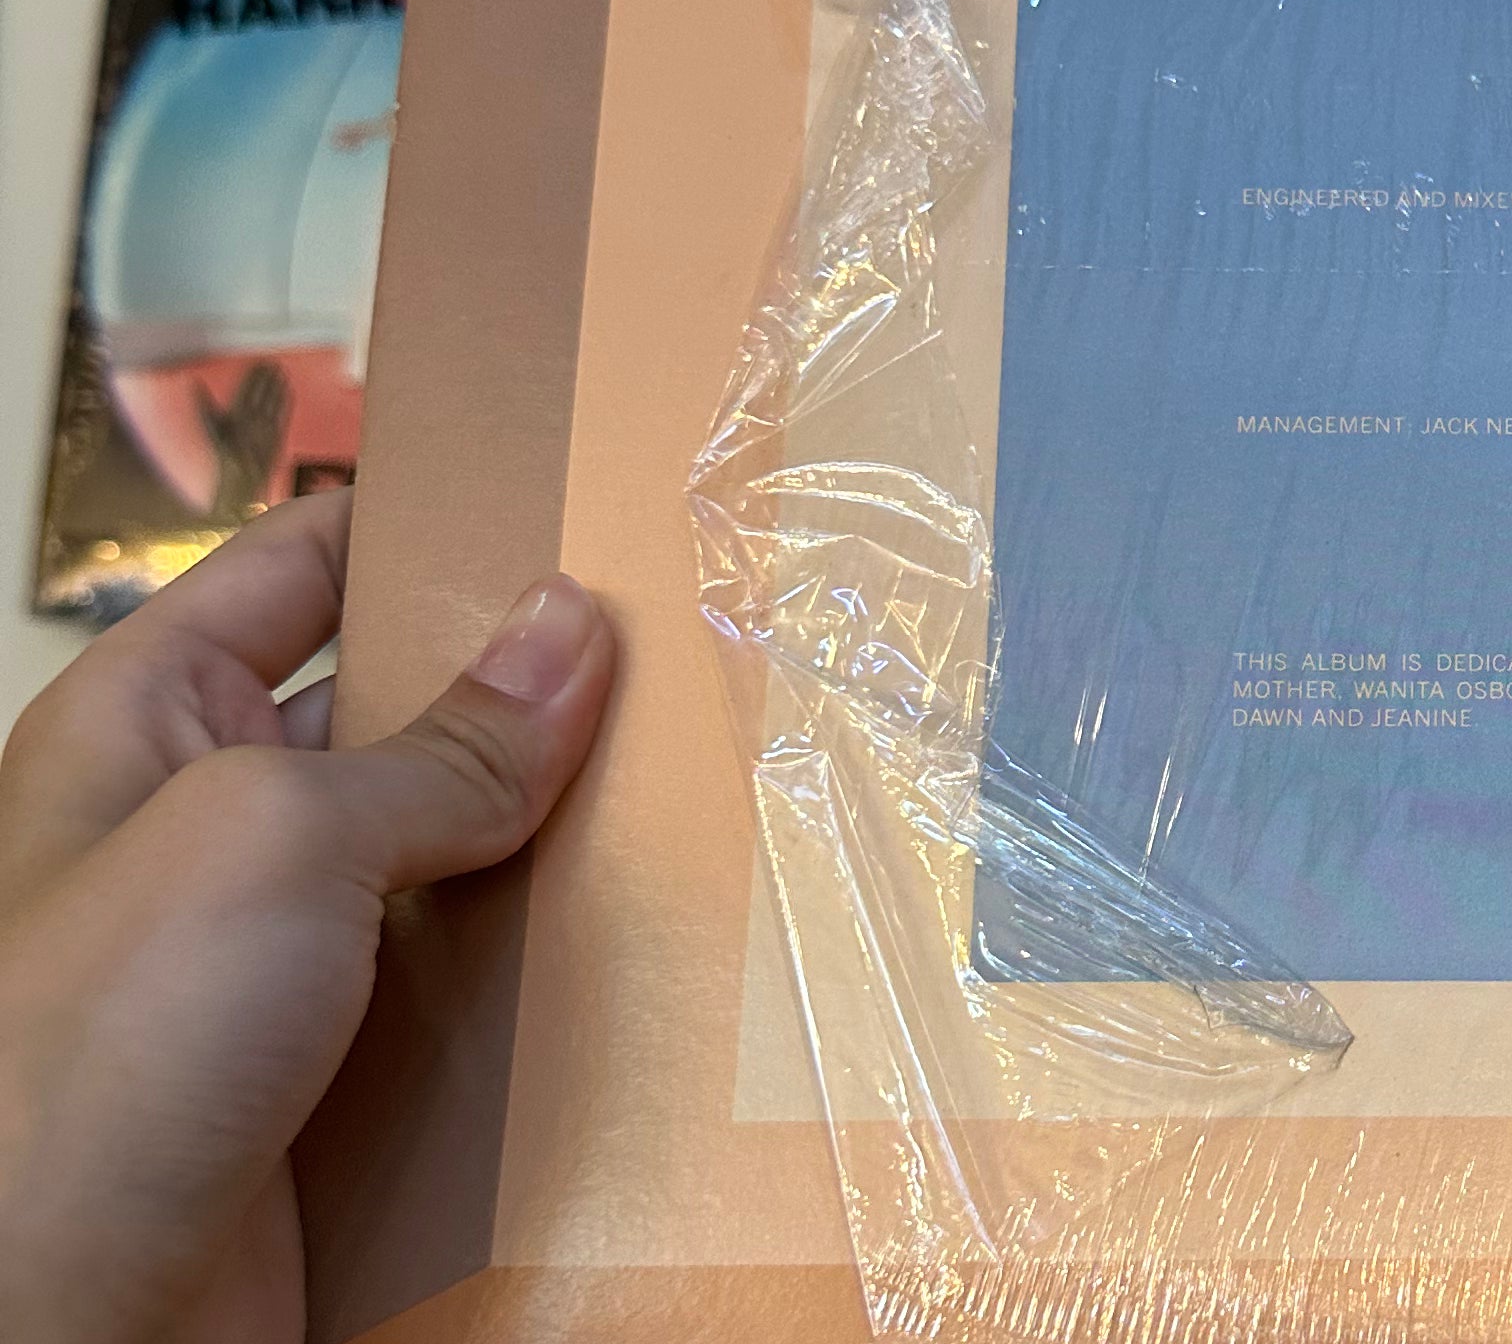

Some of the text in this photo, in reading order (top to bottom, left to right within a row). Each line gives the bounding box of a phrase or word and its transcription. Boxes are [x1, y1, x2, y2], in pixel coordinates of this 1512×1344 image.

[1241, 187, 1390, 208] ENGINEERED
[1396, 189, 1447, 209] AND
[1420, 416, 1479, 435] JACK
[1232, 652, 1288, 672] THIS
[1301, 653, 1387, 672] ALBUM
[1401, 653, 1422, 672] IS
[1353, 680, 1445, 701] WANITA
[1231, 707, 1302, 728] DAWN
[1311, 708, 1365, 728] AND
